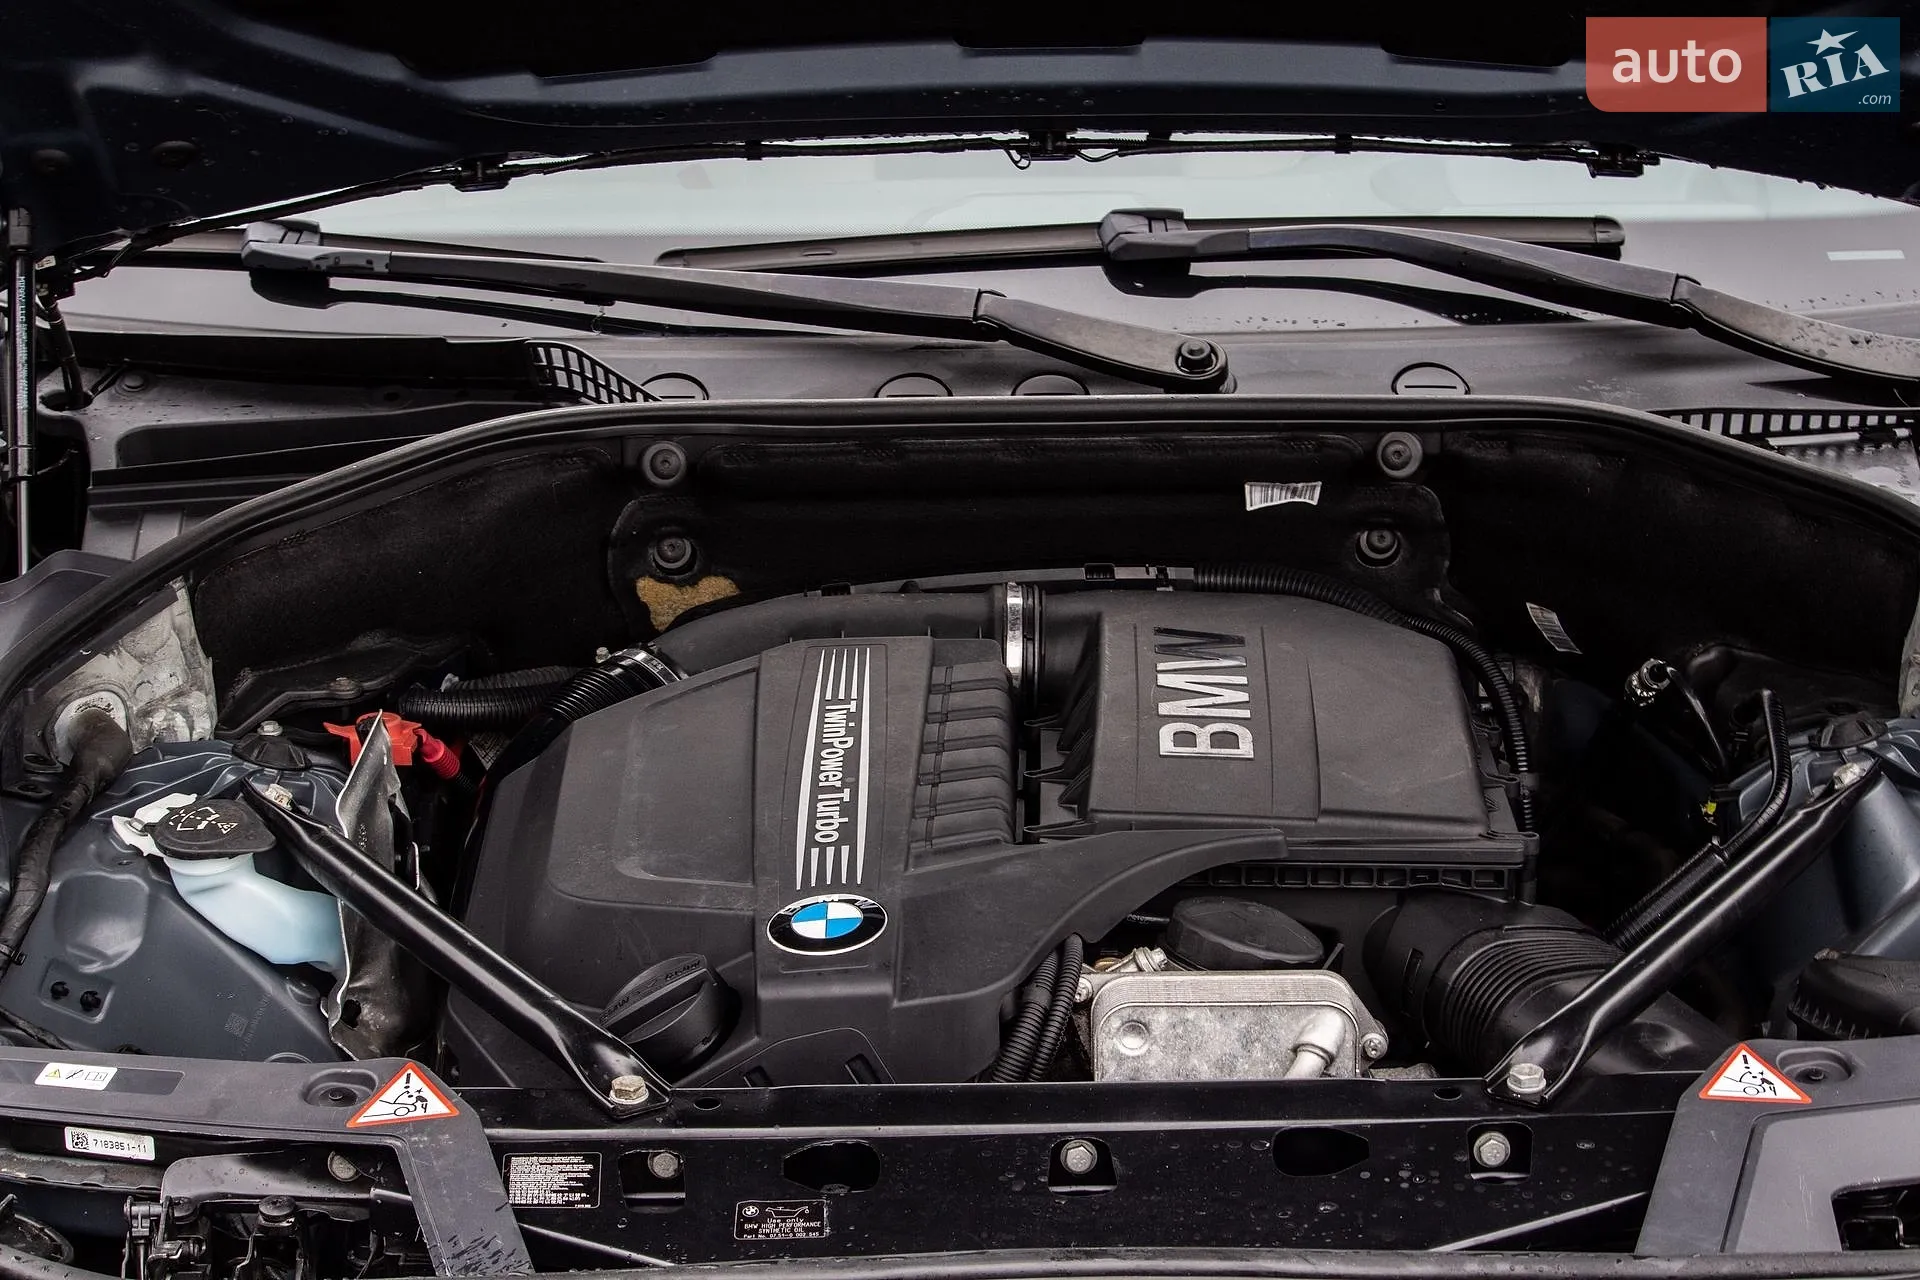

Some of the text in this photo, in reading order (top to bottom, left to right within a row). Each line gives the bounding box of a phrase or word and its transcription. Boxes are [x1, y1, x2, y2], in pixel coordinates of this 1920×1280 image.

[1153, 626, 1254, 759] BMW
[814, 700, 857, 843] TwinPower Turbo
[92, 1139, 147, 1153] 7183851-11
